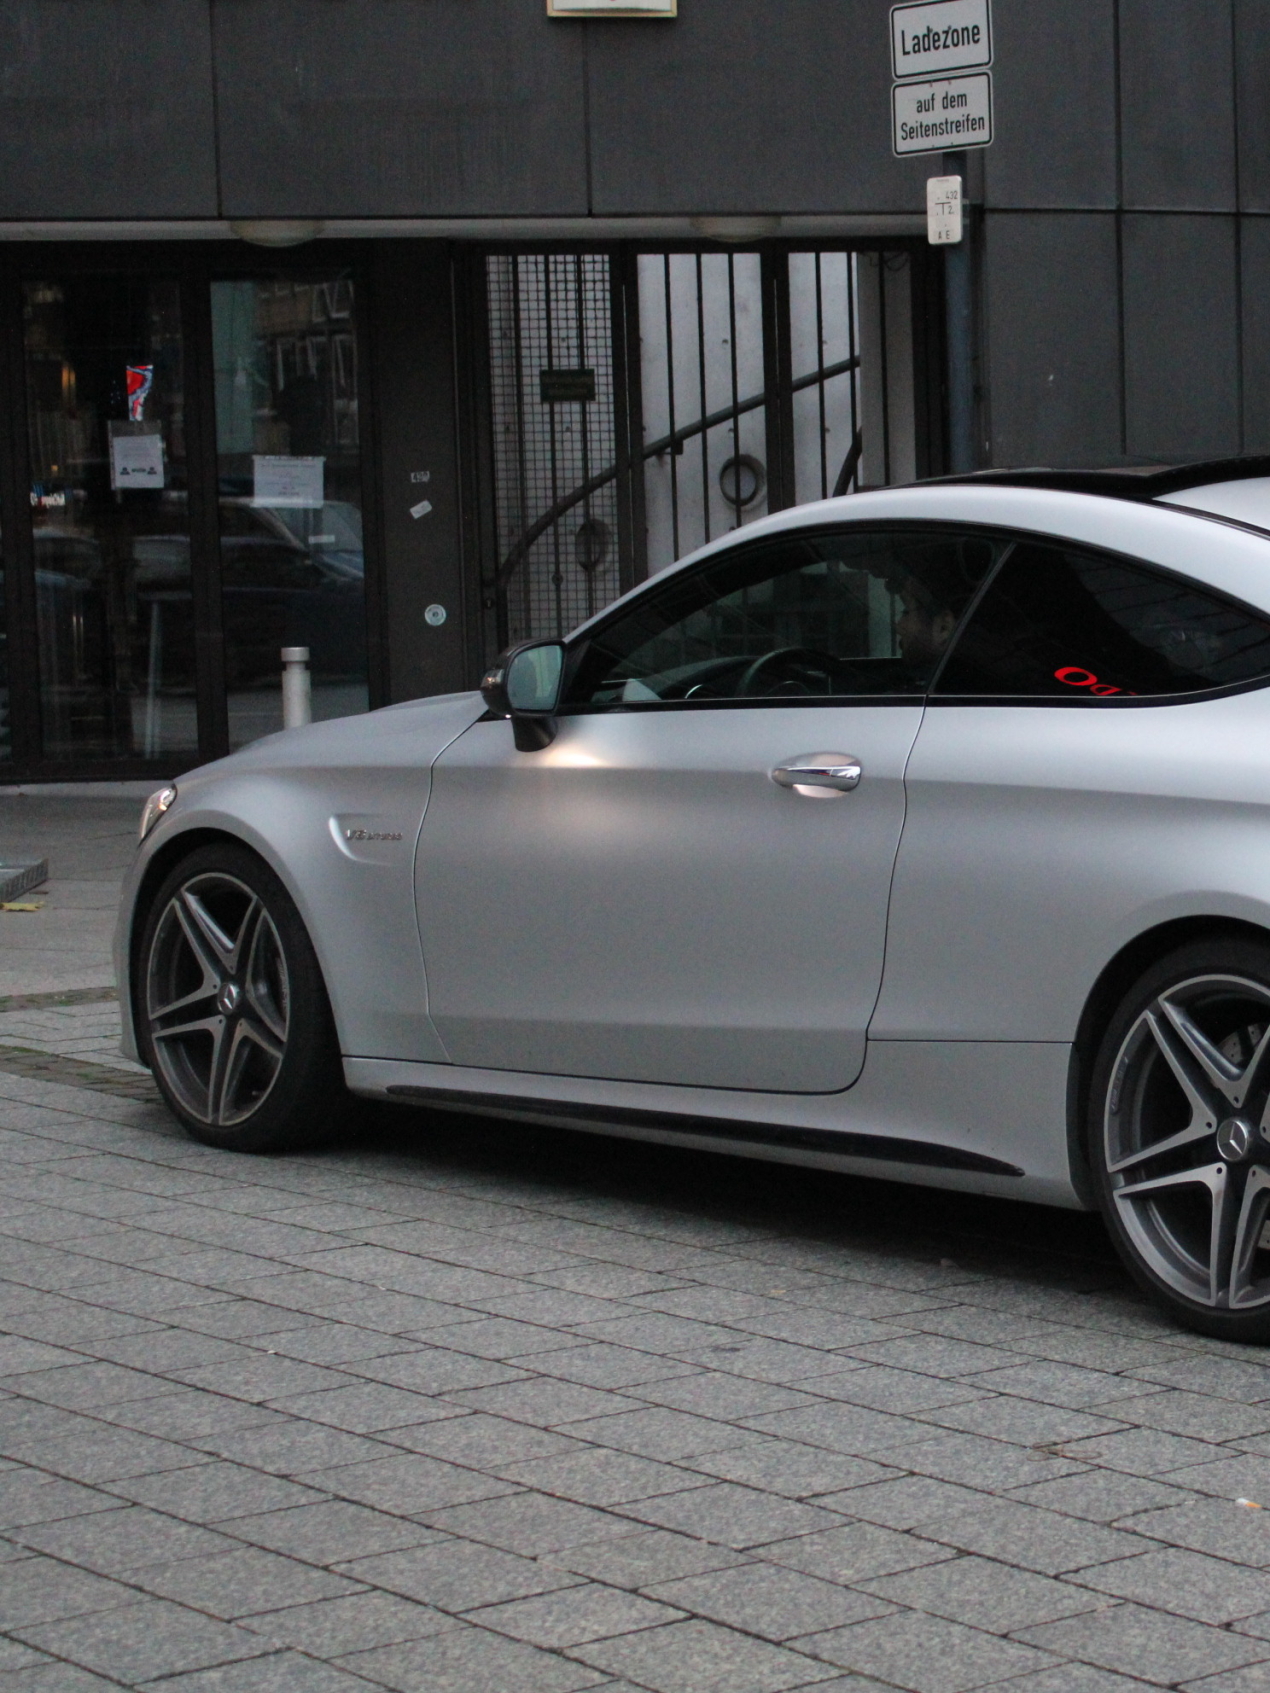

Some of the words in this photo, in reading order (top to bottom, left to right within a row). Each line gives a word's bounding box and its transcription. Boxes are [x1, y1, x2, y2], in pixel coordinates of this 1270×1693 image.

[901, 25, 981, 56] Ladezone
[916, 93, 936, 113] auf
[942, 91, 967, 110] dem
[901, 113, 985, 141] Seitenstreifen
[946, 190, 958, 200] 432
